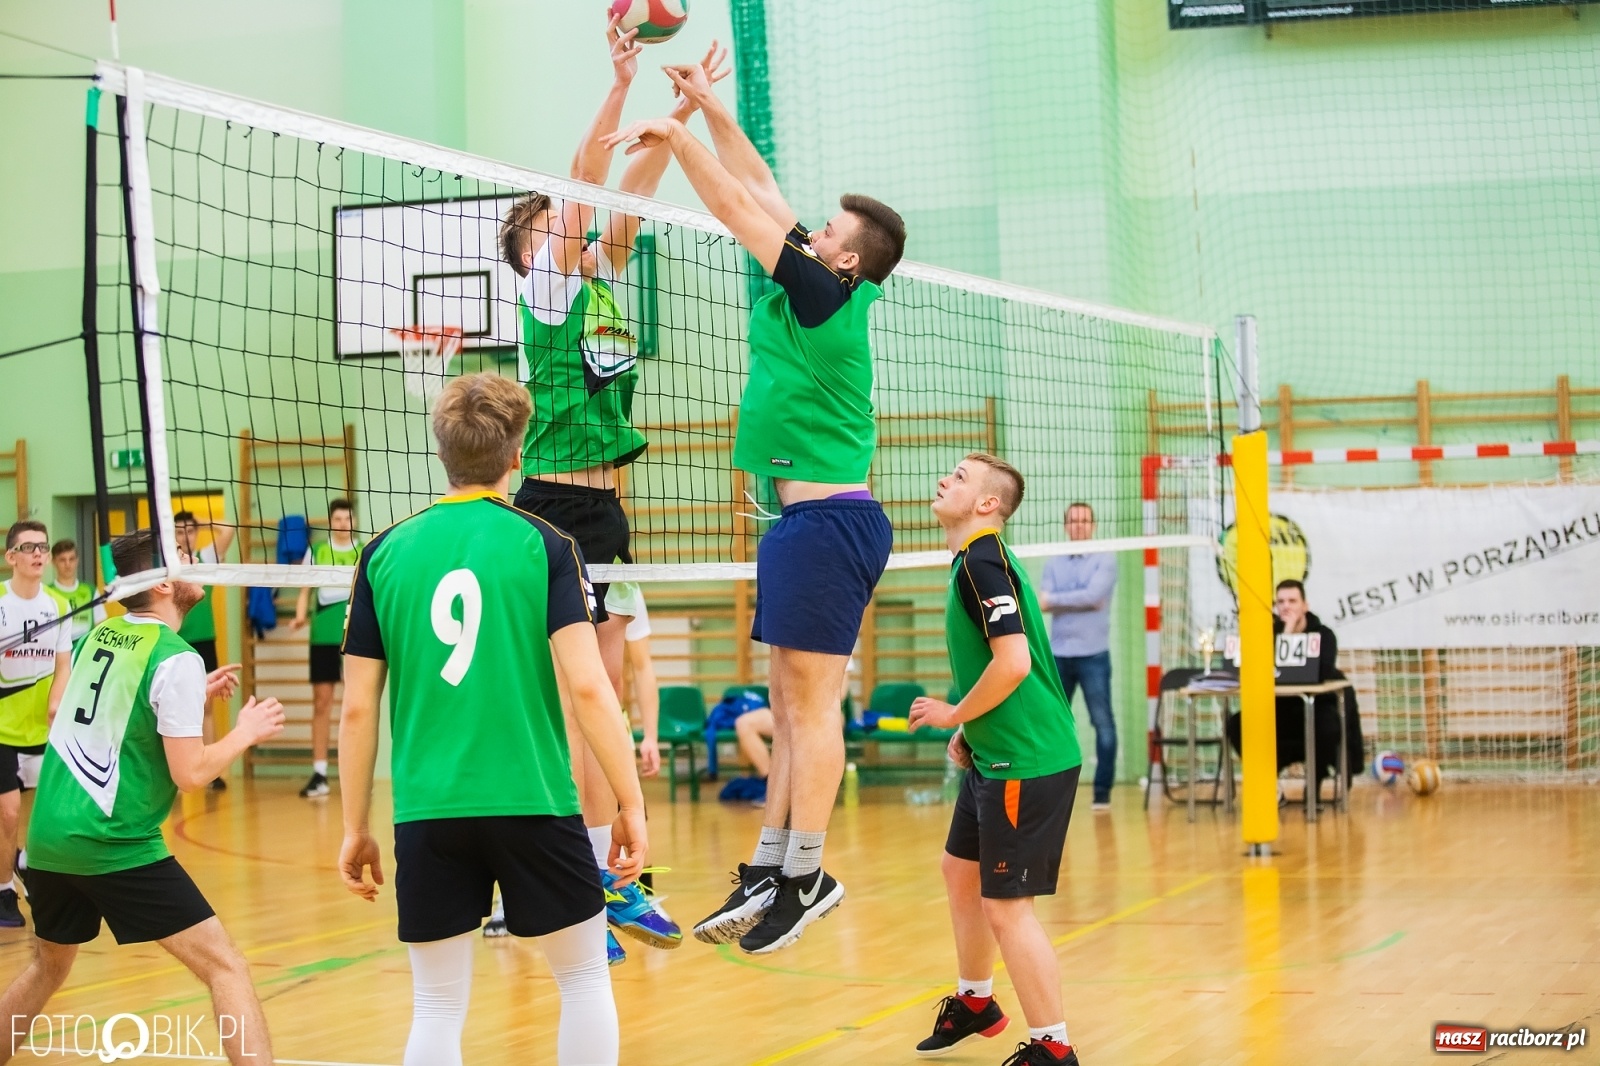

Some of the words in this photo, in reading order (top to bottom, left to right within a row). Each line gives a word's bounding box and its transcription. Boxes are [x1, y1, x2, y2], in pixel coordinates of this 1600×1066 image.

[1333, 578, 1399, 622] JEST
[1408, 568, 1435, 594] W
[1442, 512, 1600, 584] PORZĄDKU
[12, 648, 55, 658] PARTNER
[23, 619, 39, 644] 12
[430, 568, 482, 687] 9
[74, 647, 115, 726] 3
